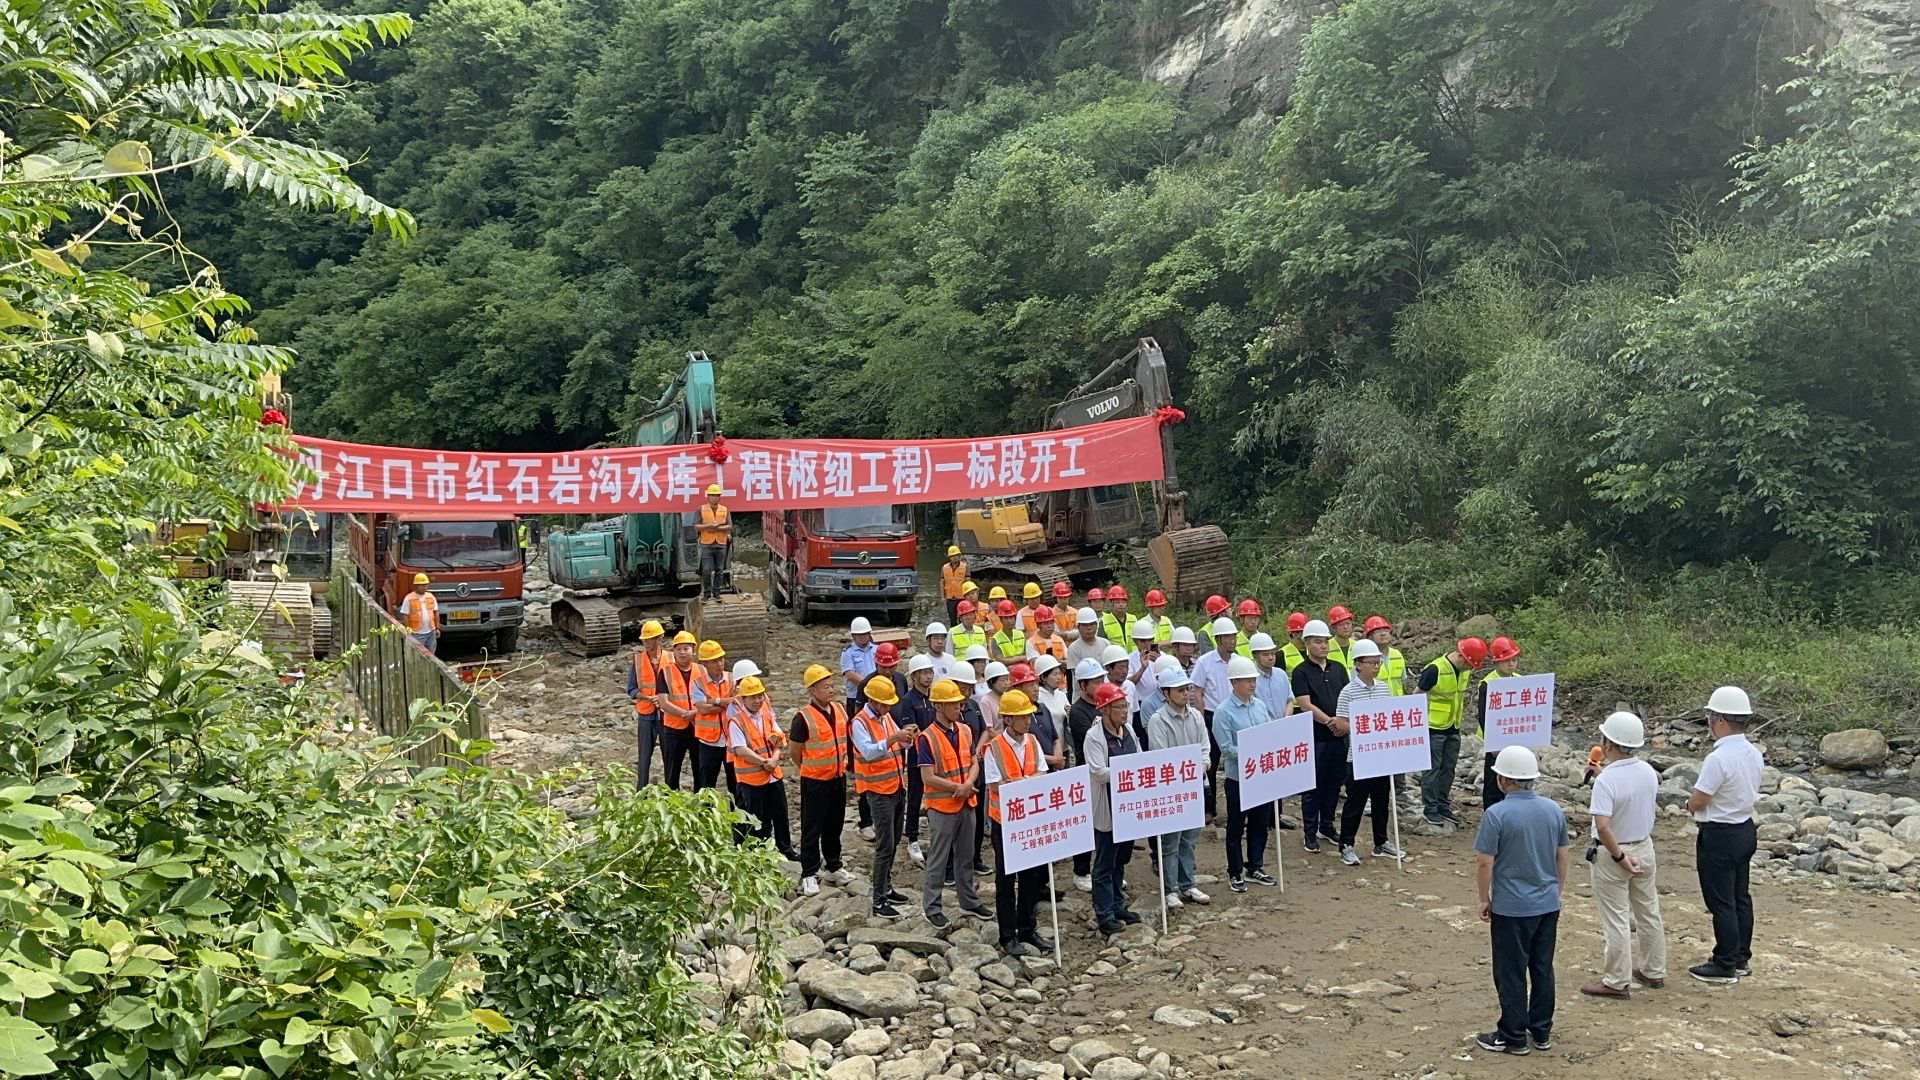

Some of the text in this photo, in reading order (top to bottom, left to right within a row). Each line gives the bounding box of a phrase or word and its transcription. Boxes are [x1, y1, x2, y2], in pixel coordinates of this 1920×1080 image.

[1087, 396, 1119, 418] VOLVO
[1489, 687, 1547, 711] 施工单位
[1355, 708, 1423, 735] 建设单位
[1503, 724, 1537, 735] 工程有限公司
[1358, 737, 1425, 752] 丹江口市水利和湖泊局
[1244, 743, 1309, 779] 乡镇政府
[1117, 760, 1198, 793] 监理单位
[1006, 782, 1086, 822] 施工单位
[1119, 791, 1198, 813] 丹江口市汉江工程咨询
[1136, 805, 1184, 821] 有限责任公司
[1022, 831, 1068, 851] 工程有限公司
